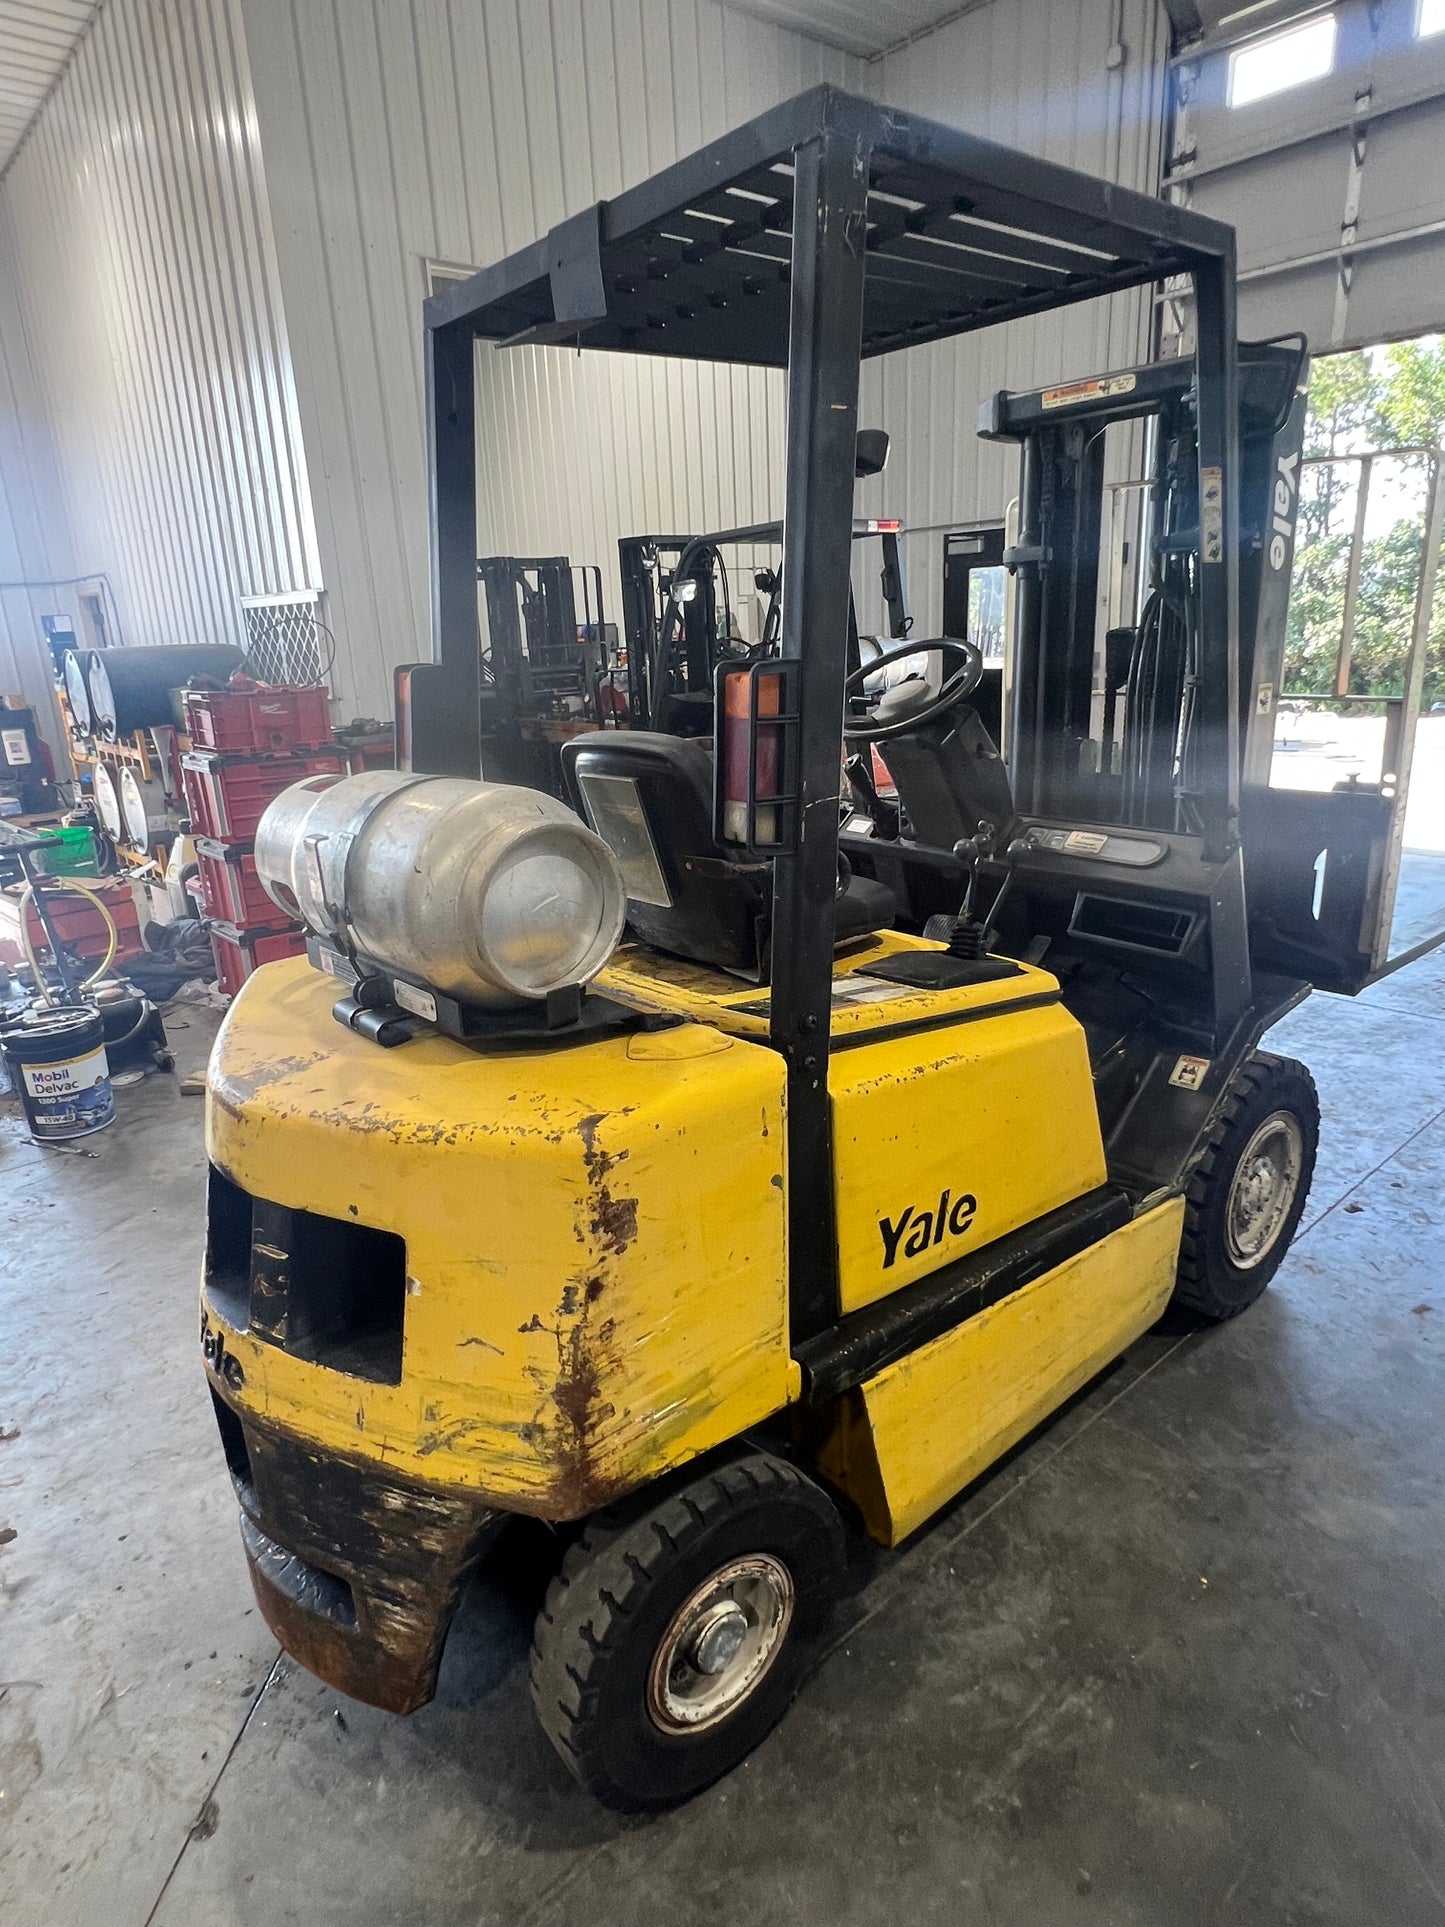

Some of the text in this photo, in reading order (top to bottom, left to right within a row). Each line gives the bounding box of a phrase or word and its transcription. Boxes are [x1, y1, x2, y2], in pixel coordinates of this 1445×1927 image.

[1270, 452, 1298, 570] Yale
[32, 1069, 69, 1082] Mobil
[35, 1080, 79, 1094] Delvac
[879, 1188, 977, 1270] Yale
